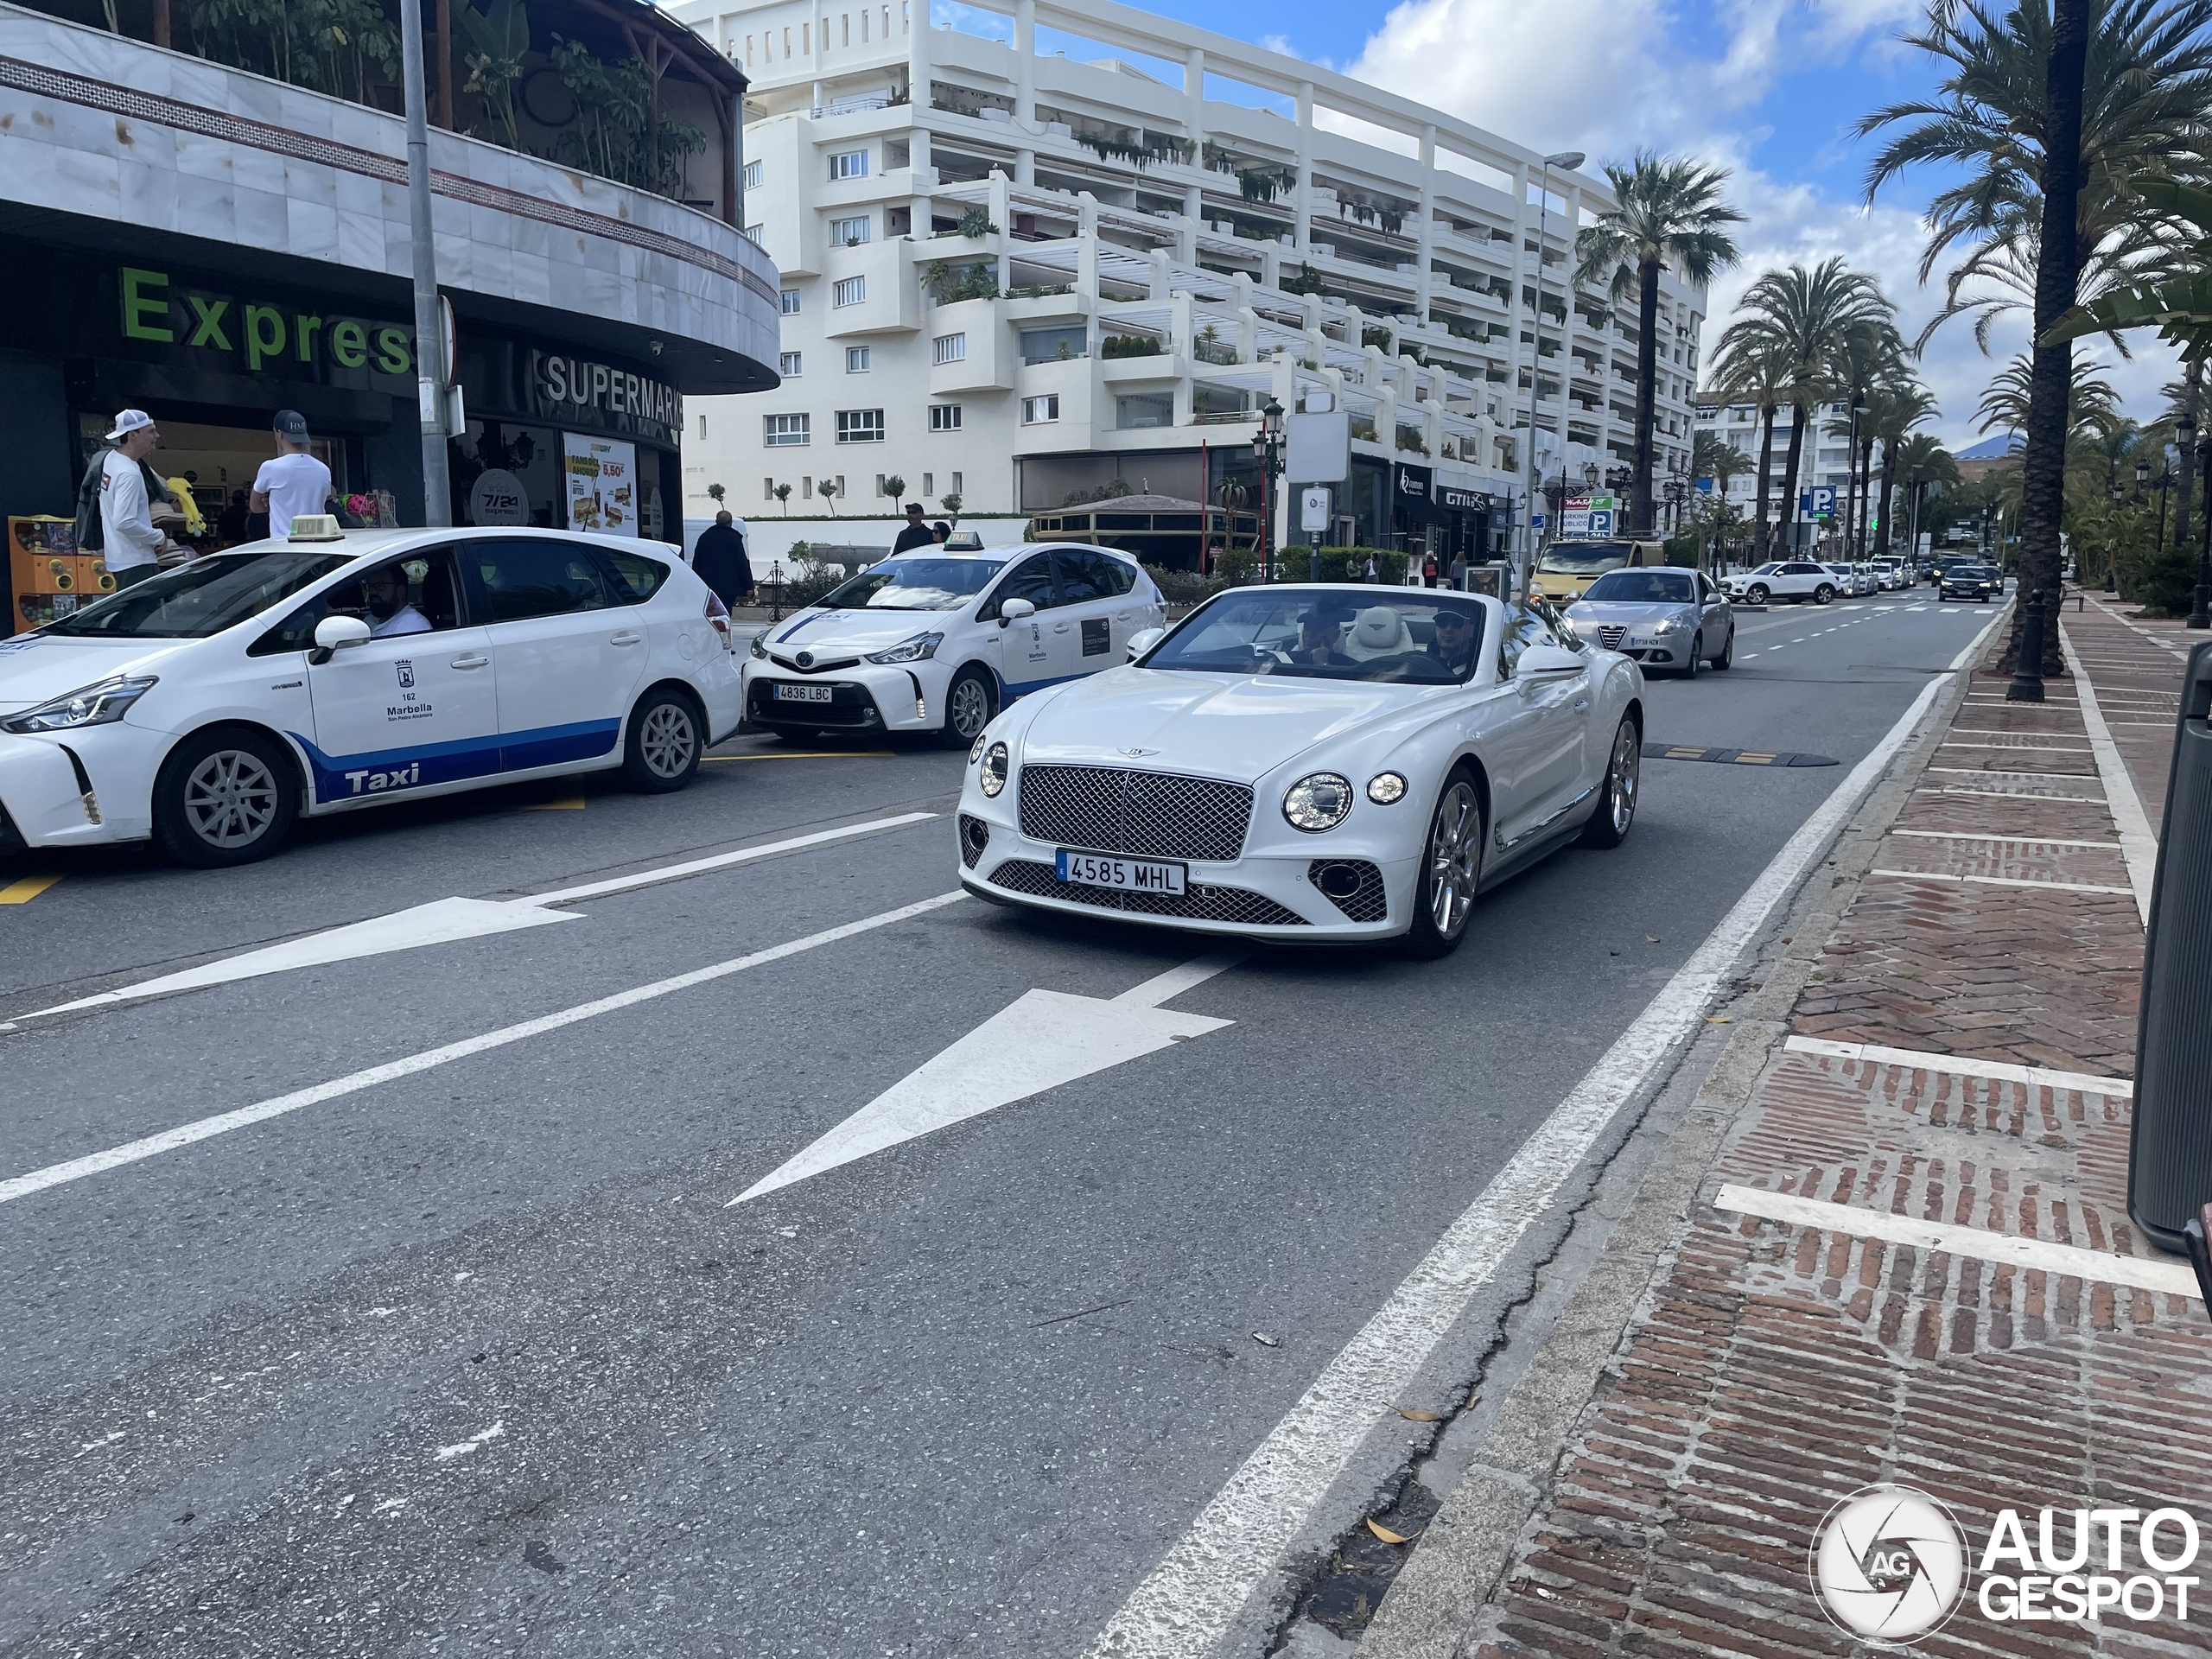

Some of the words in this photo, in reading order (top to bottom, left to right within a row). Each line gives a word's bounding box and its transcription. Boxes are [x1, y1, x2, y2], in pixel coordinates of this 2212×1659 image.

[120, 266, 411, 374] Expres
[547, 356, 683, 431] SUPERMARKE
[572, 466, 599, 478] AHORRO
[481, 493, 518, 508] 7/24
[1813, 489, 1832, 511] P
[1593, 514, 1607, 531] P
[952, 533, 967, 542] TAXI
[402, 692, 416, 702] 162
[780, 686, 805, 699] 4836
[809, 688, 830, 701] LBC
[387, 703, 432, 716] Marbella
[345, 762, 419, 793] Taxi
[1071, 857, 1126, 885] 4585
[1135, 865, 1179, 891] MHL
